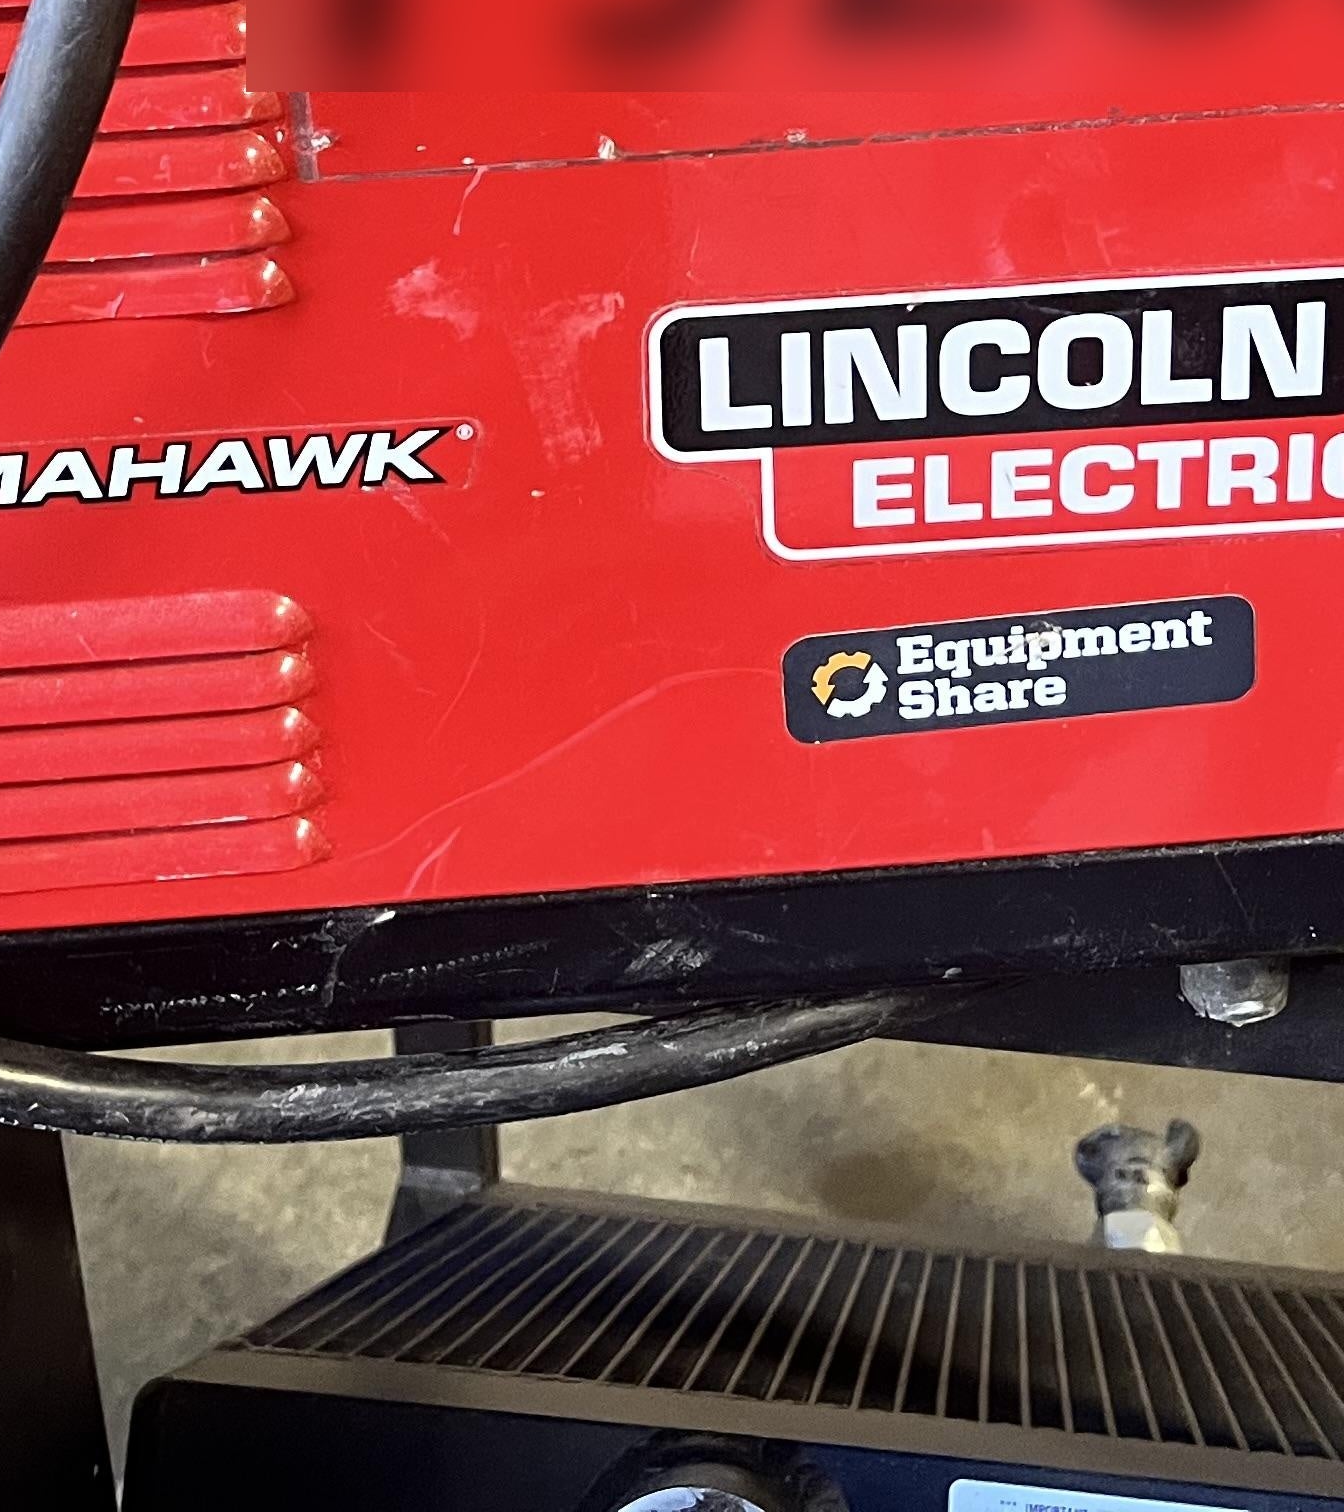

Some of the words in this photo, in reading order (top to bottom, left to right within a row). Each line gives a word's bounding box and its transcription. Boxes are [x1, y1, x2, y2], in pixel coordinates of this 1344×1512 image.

[698, 300, 1329, 432] LINCOLN
[896, 609, 1213, 678] Equipment
[897, 674, 1067, 720] Share
